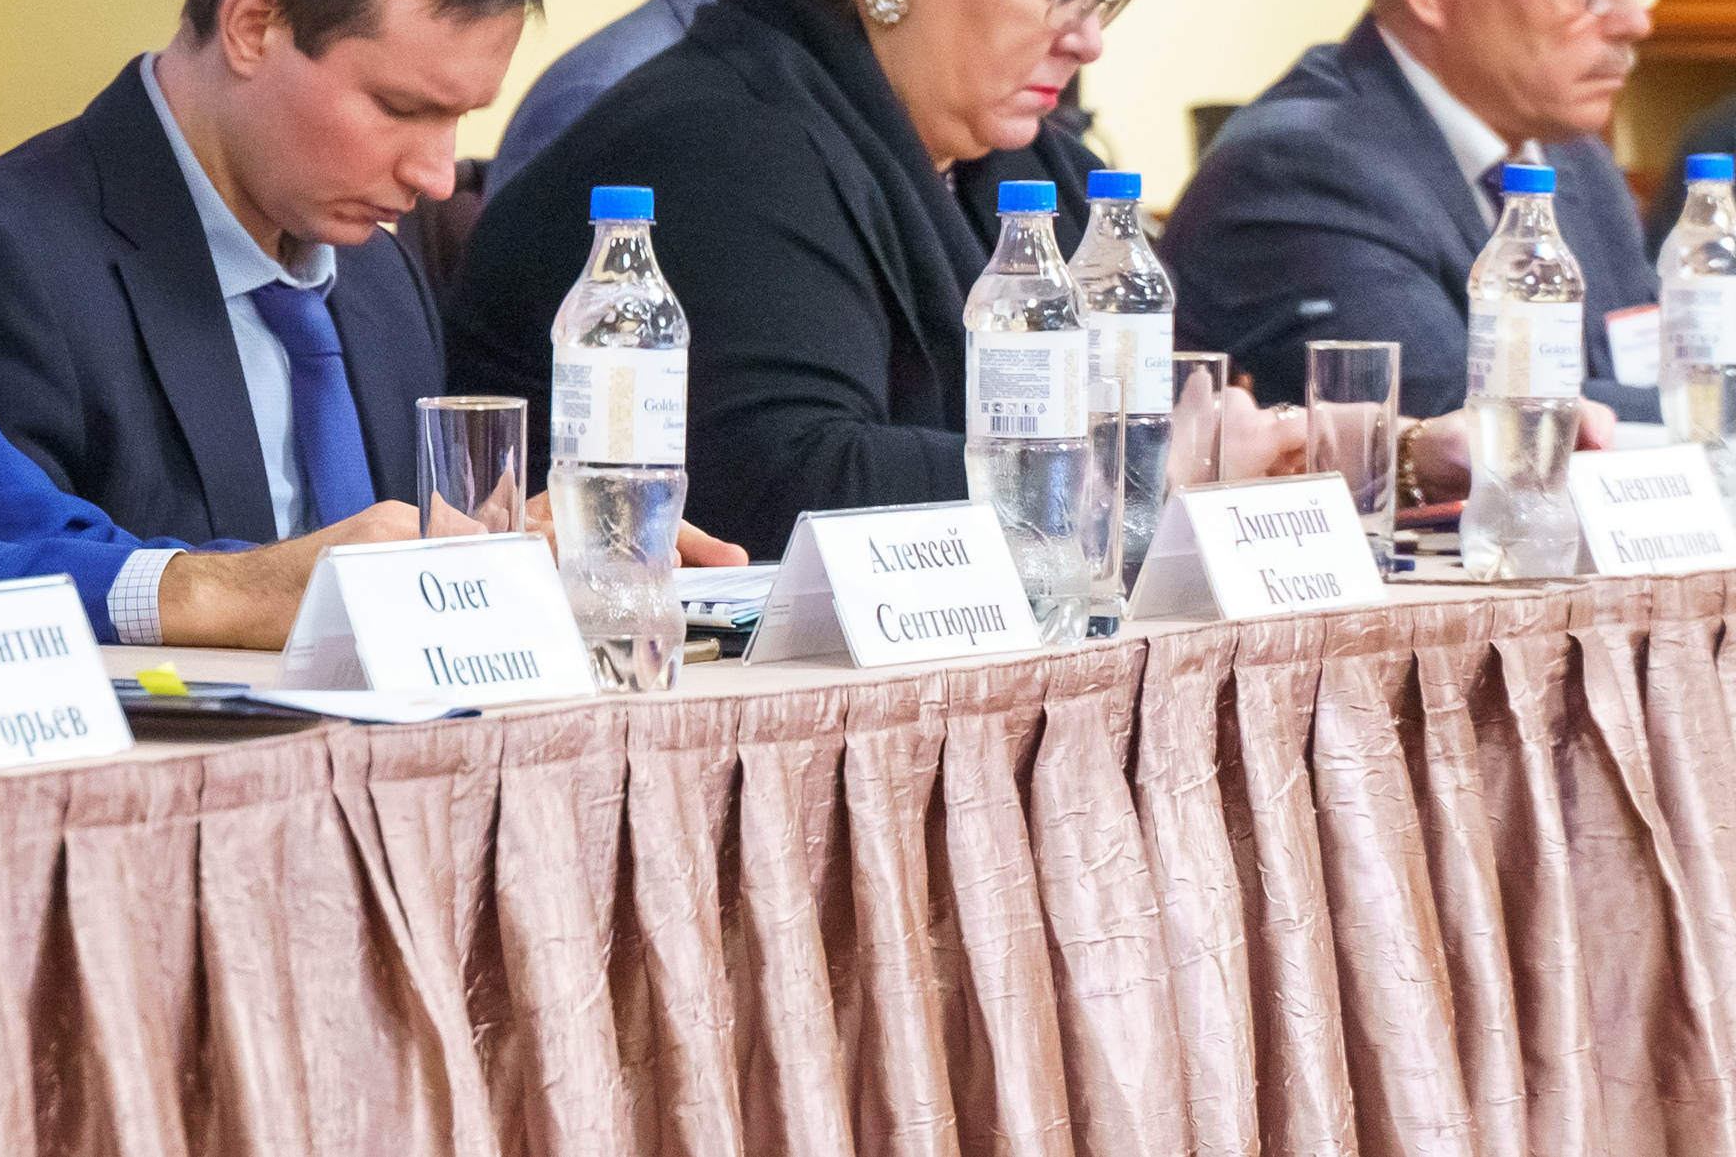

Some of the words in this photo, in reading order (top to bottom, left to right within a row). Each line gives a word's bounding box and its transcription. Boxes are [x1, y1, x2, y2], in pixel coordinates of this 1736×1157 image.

[1597, 472, 1694, 506] Алевтина
[1225, 498, 1332, 551] Дмитрий
[867, 527, 972, 575] Алексей
[1609, 529, 1723, 573] Кириллова
[417, 570, 491, 614] Олег
[1258, 568, 1343, 612] Кусков
[875, 601, 1008, 647] Сентюрин
